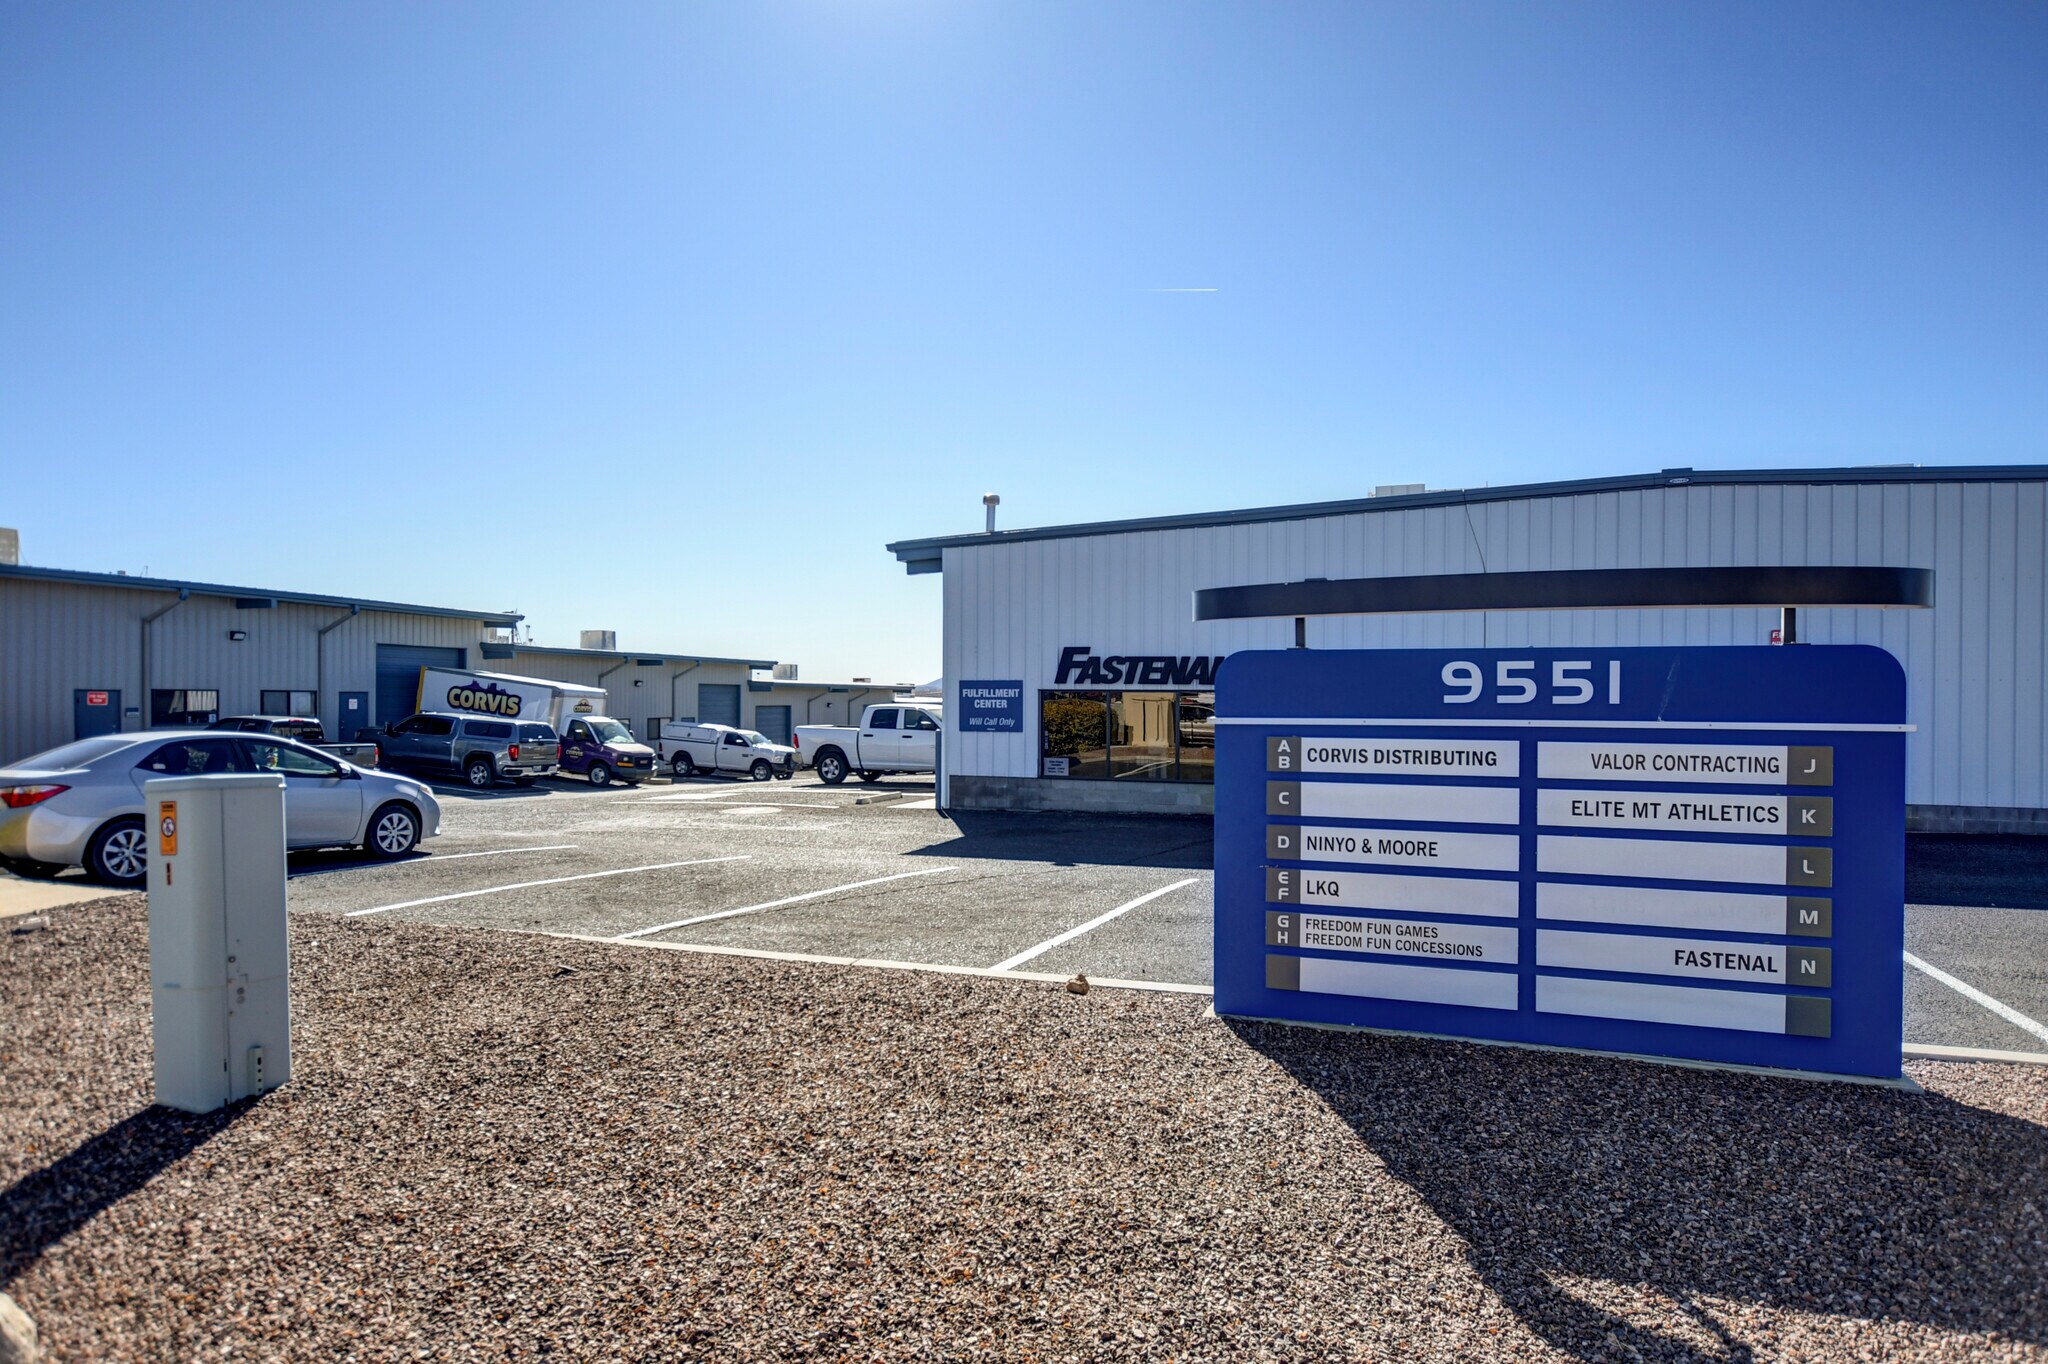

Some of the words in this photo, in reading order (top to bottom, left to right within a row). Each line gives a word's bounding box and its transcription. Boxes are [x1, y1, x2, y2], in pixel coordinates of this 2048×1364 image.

[1441, 660, 1621, 705] 9551
[448, 687, 520, 715] CORVIS
[962, 688, 1020, 698] FULFILLMENT
[974, 699, 1008, 709] CENTER
[969, 717, 983, 726] Will
[983, 717, 998, 726] Call
[999, 717, 1016, 728] Only
[1277, 739, 1291, 753] A
[1278, 755, 1290, 769] B
[1306, 747, 1369, 763] CORVIS
[1373, 750, 1497, 767] DISTRIBUTING
[1591, 753, 1646, 770] VALOR
[1652, 754, 1780, 774] CONTRACTING
[1803, 758, 1816, 774] J
[1278, 791, 1290, 805] C
[1571, 800, 1625, 817] ELITE
[1632, 801, 1661, 819] MT
[1667, 803, 1779, 823] ATHLETICS
[1801, 809, 1817, 824] K
[1277, 835, 1290, 849] D
[1306, 835, 1356, 853] NINYO
[1361, 838, 1373, 854] &
[1378, 839, 1438, 857] MOORE
[1802, 859, 1815, 875] L
[1278, 871, 1289, 885] E
[1278, 887, 1289, 900] F
[1306, 880, 1340, 898] LKQ
[1277, 915, 1289, 928] G
[1799, 909, 1819, 925] M
[1305, 918, 1363, 933] FREEDOM
[1366, 922, 1391, 935] FUN
[1395, 924, 1438, 939] GAMES
[1277, 931, 1289, 945] H
[1305, 933, 1363, 948] FREEDOM
[1366, 937, 1391, 950] FUN
[1395, 939, 1483, 957] CONCESSIONS
[1674, 949, 1778, 973] FASTENAL
[1800, 959, 1816, 975] N
